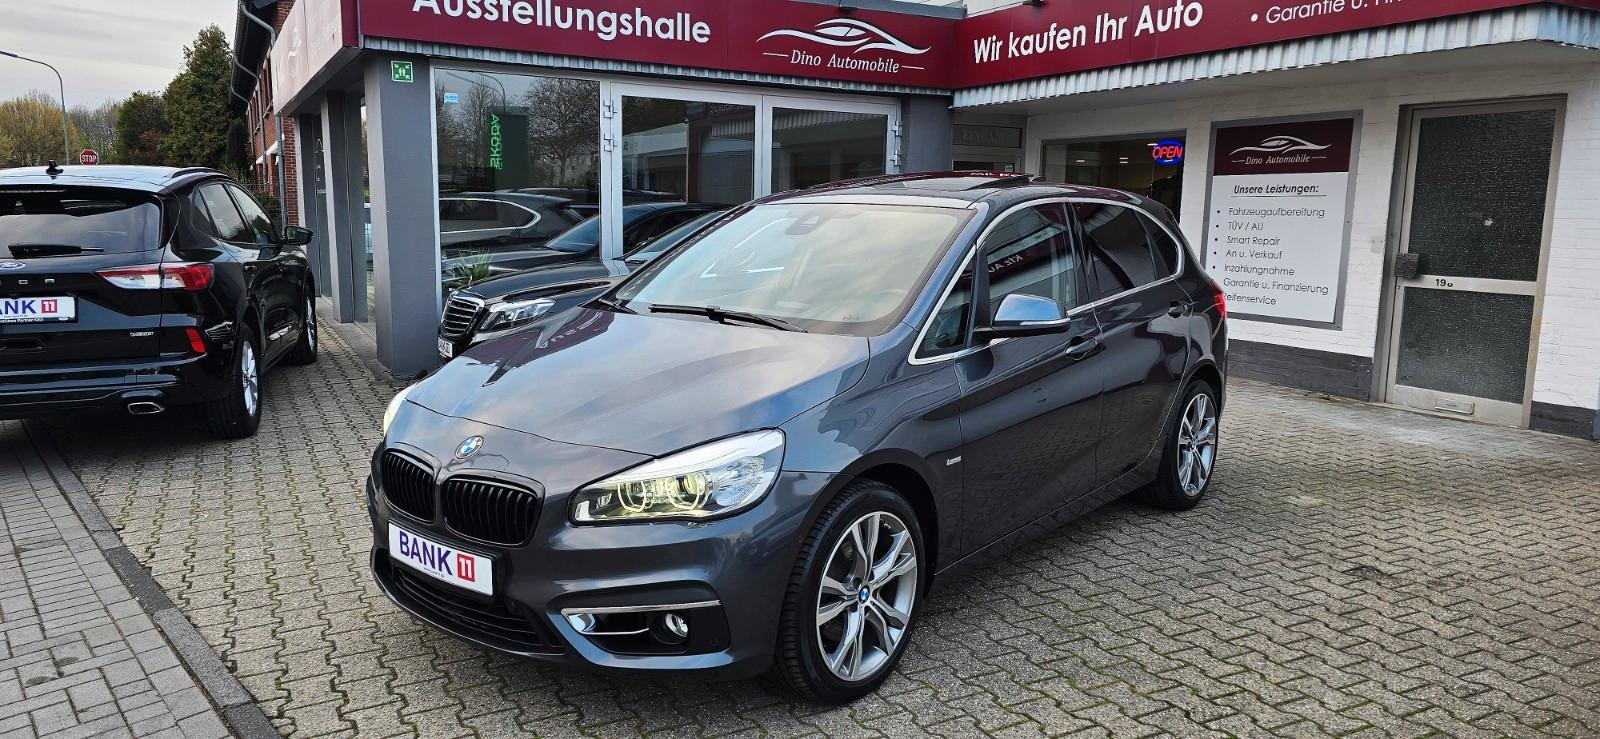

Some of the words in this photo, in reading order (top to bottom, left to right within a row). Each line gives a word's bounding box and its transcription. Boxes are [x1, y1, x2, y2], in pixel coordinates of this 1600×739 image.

[1266, 0, 1345, 24] Garantie
[412, 0, 711, 43] Ausstellungshalle
[973, 34, 1003, 64] Wir
[1007, 23, 1086, 58] kaufen
[1094, 13, 1128, 44] Ihr
[1134, 0, 1204, 37] Auto
[790, 49, 822, 66] Dino
[827, 53, 900, 73] Automobile
[81, 154, 97, 163] STOP
[1152, 145, 1184, 159] OPEN
[1245, 156, 1263, 165] Dino
[1265, 153, 1310, 164] Automobile
[1233, 185, 1263, 194] Unsere
[1265, 184, 1319, 194] Leistungen:
[1228, 207, 1325, 219] Fahrzeugaufbereitung
[1228, 221, 1243, 231] TÜV
[1251, 222, 1264, 231] AU
[1226, 235, 1251, 245] Smart
[1252, 237, 1281, 247] Repair
[1225, 249, 1238, 258] An
[1249, 250, 1284, 260] Verkauf
[1223, 263, 1295, 276] Inzahlungnahme
[1223, 277, 1260, 289] Garantie
[1261, 282, 1271, 290] u.
[1272, 280, 1329, 296] Finanzierung
[42, 299, 58, 314] 11
[399, 530, 453, 576] BANK
[457, 553, 475, 582] 11
